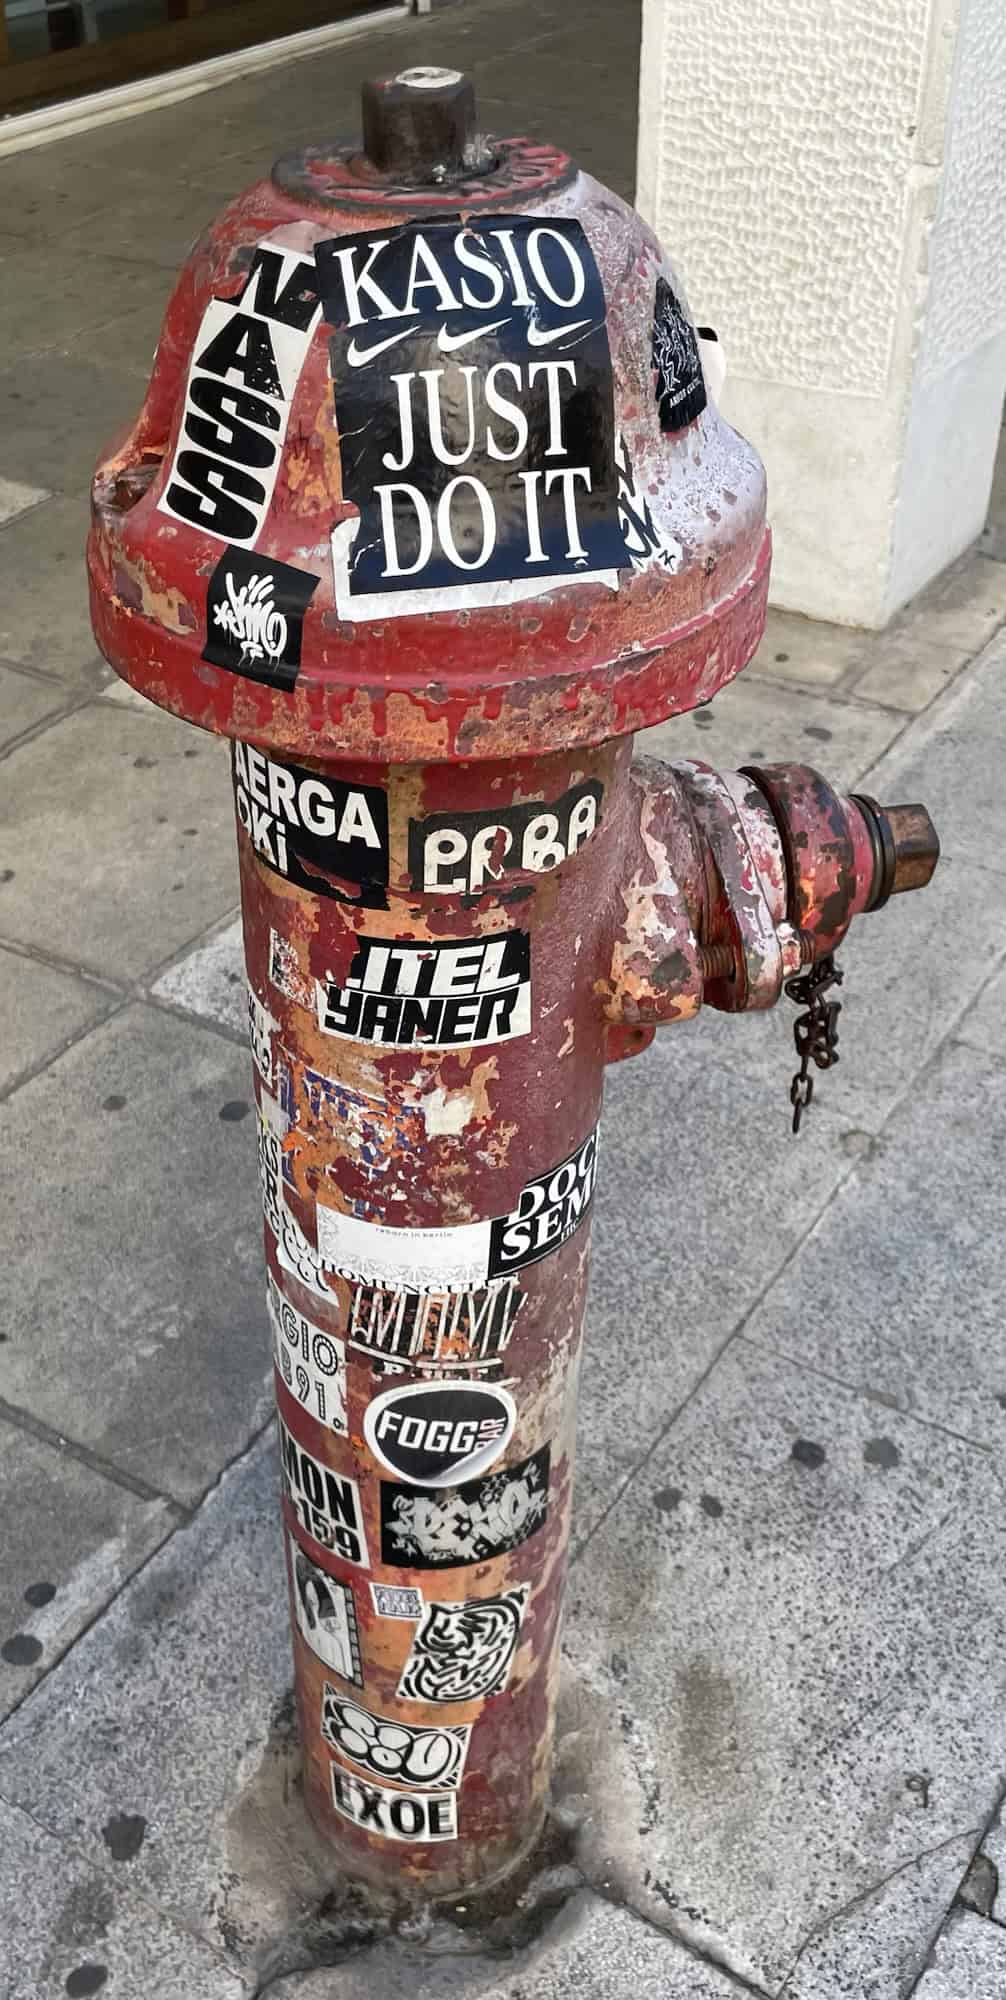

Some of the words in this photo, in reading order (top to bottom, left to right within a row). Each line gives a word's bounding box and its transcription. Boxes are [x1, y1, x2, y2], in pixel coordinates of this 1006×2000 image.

[332, 228, 585, 327] KASIO
[382, 360, 577, 471] JUST
[374, 475, 497, 577] DO
[518, 467, 592, 562] IT
[346, 940, 521, 997] ITEL
[377, 1409, 479, 1453] FOGG
